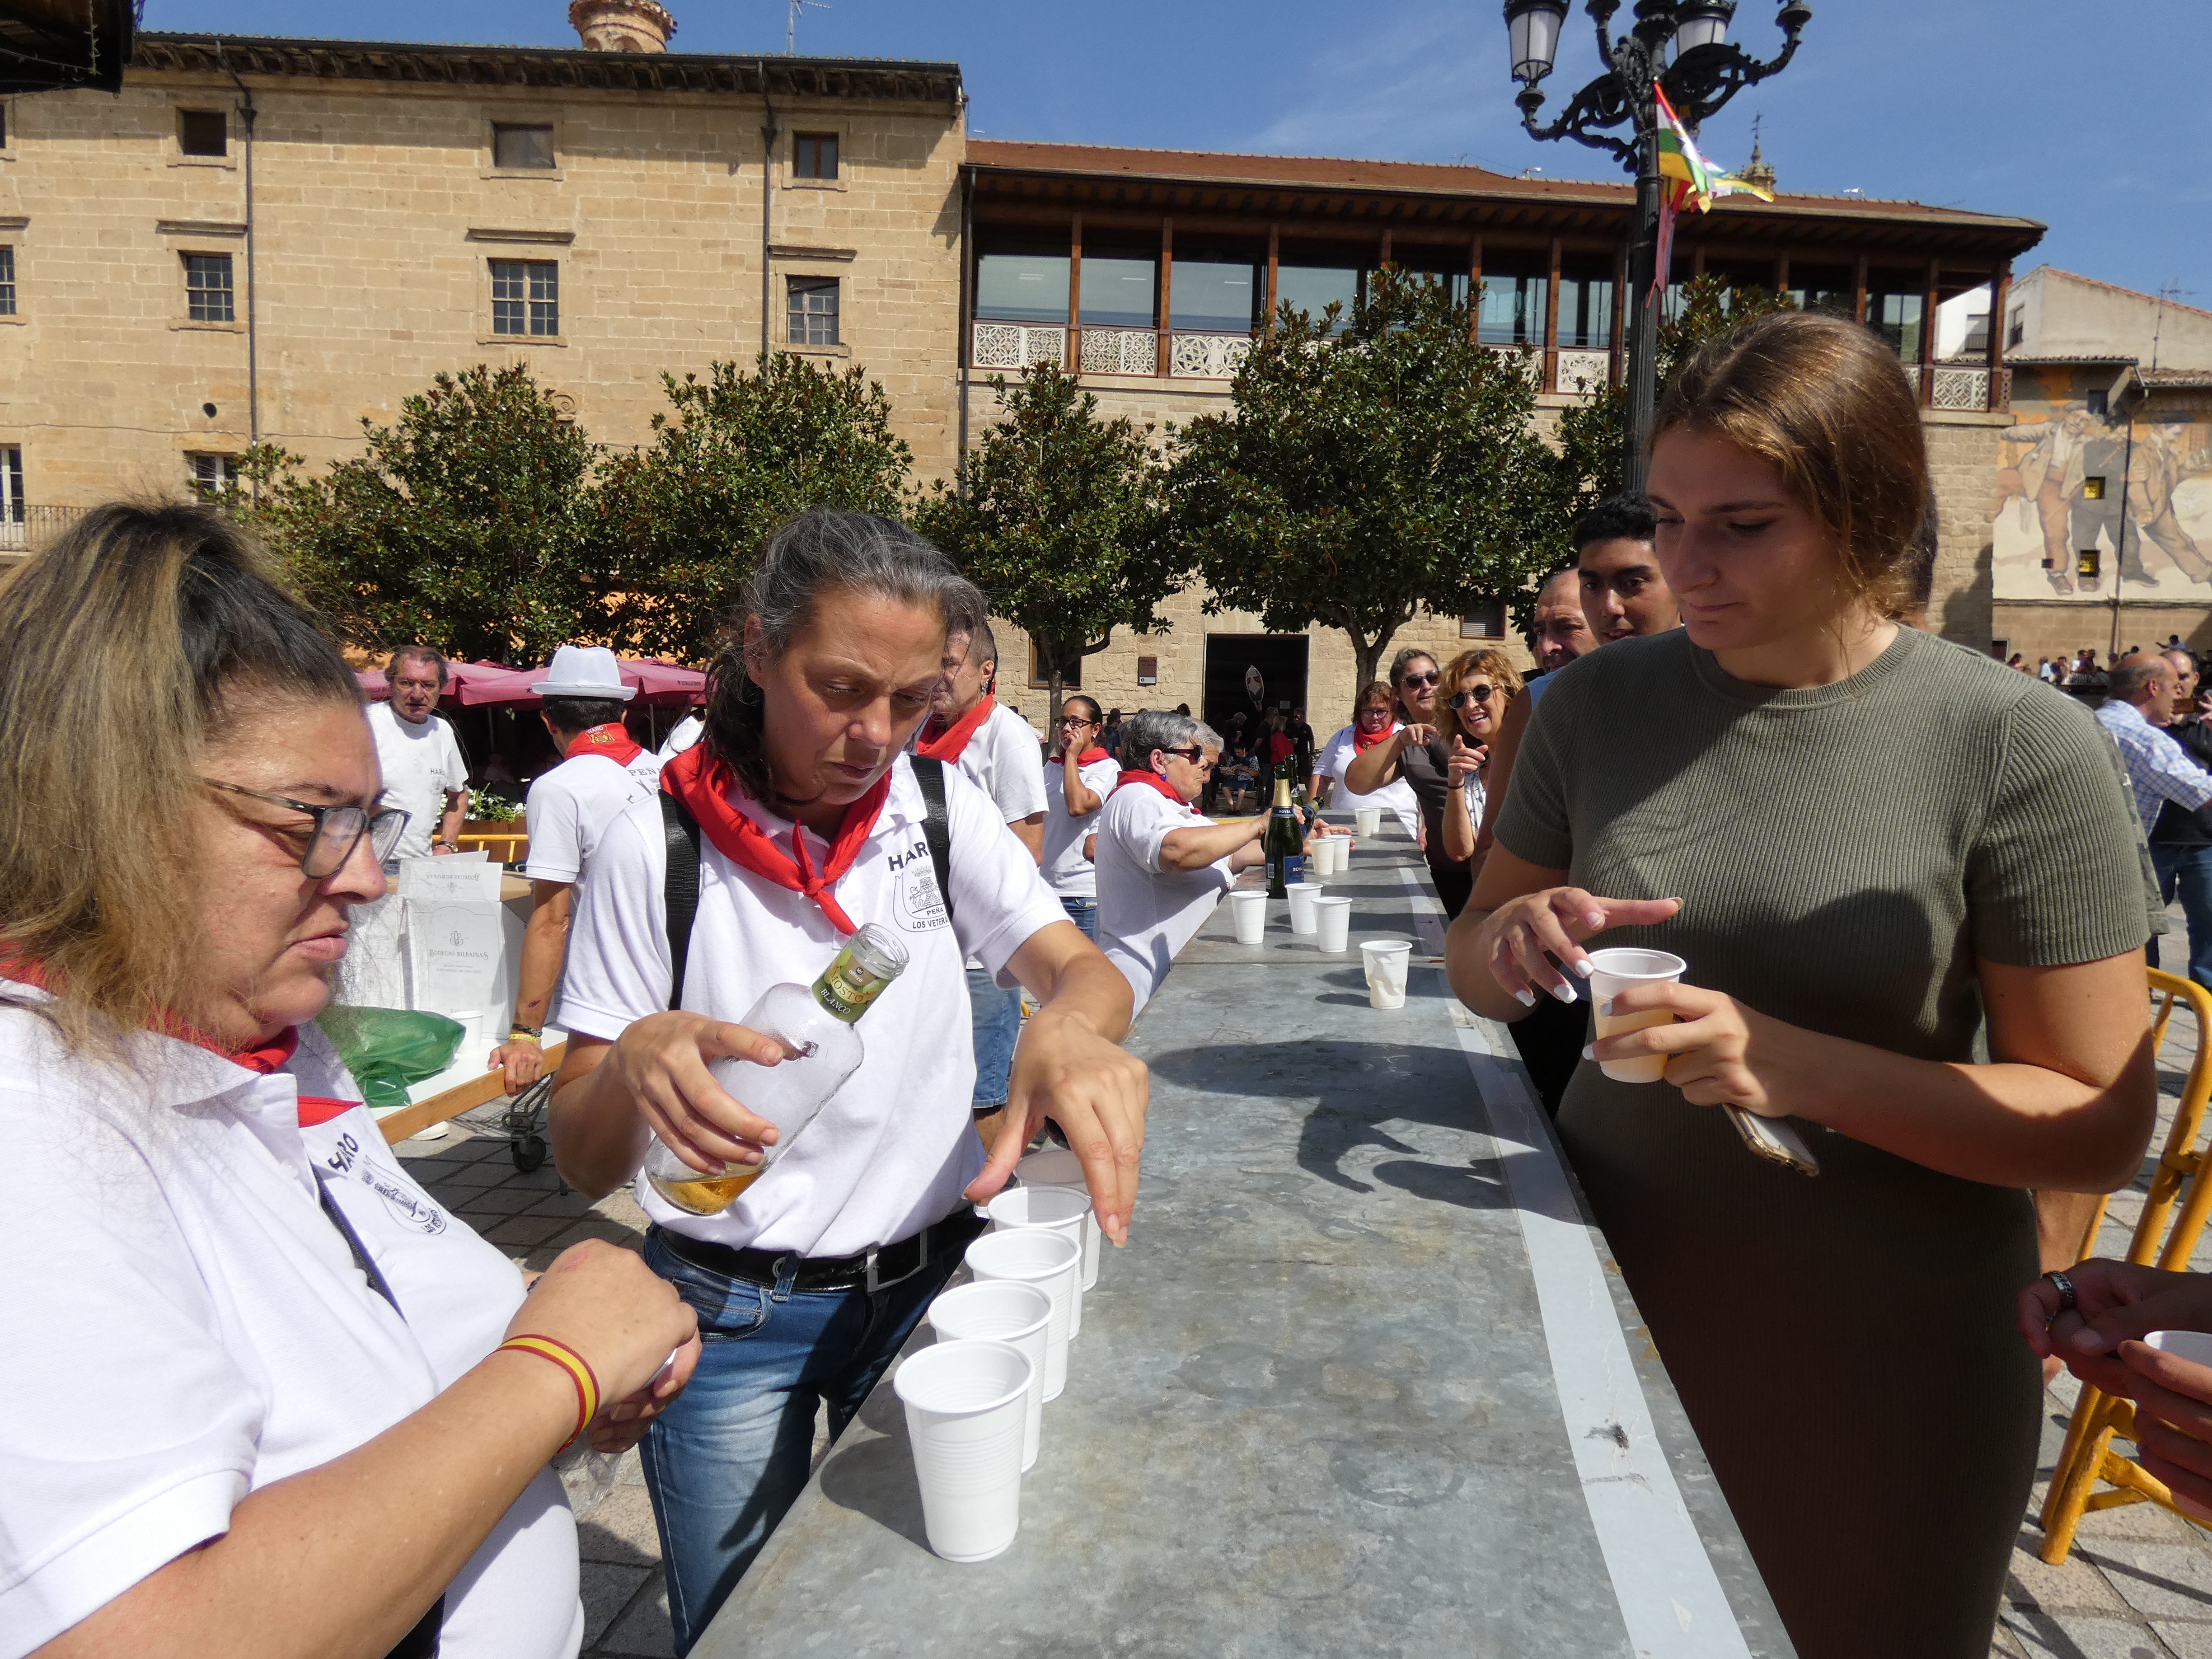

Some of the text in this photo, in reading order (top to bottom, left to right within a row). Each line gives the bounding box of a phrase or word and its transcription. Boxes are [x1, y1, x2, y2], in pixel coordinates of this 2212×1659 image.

[587, 725, 604, 734] HARO
[888, 842, 929, 872] HAR
[454, 873, 480, 881] BODEGAS
[926, 907, 944, 916] PEÑA
[913, 917, 949, 929] LOS VETERA
[430, 949, 488, 960] BODEGAS BILBAINAS
[849, 970, 863, 983] alteza
[830, 971, 863, 1002] MOSTO
[820, 989, 851, 1014] BLANCO
